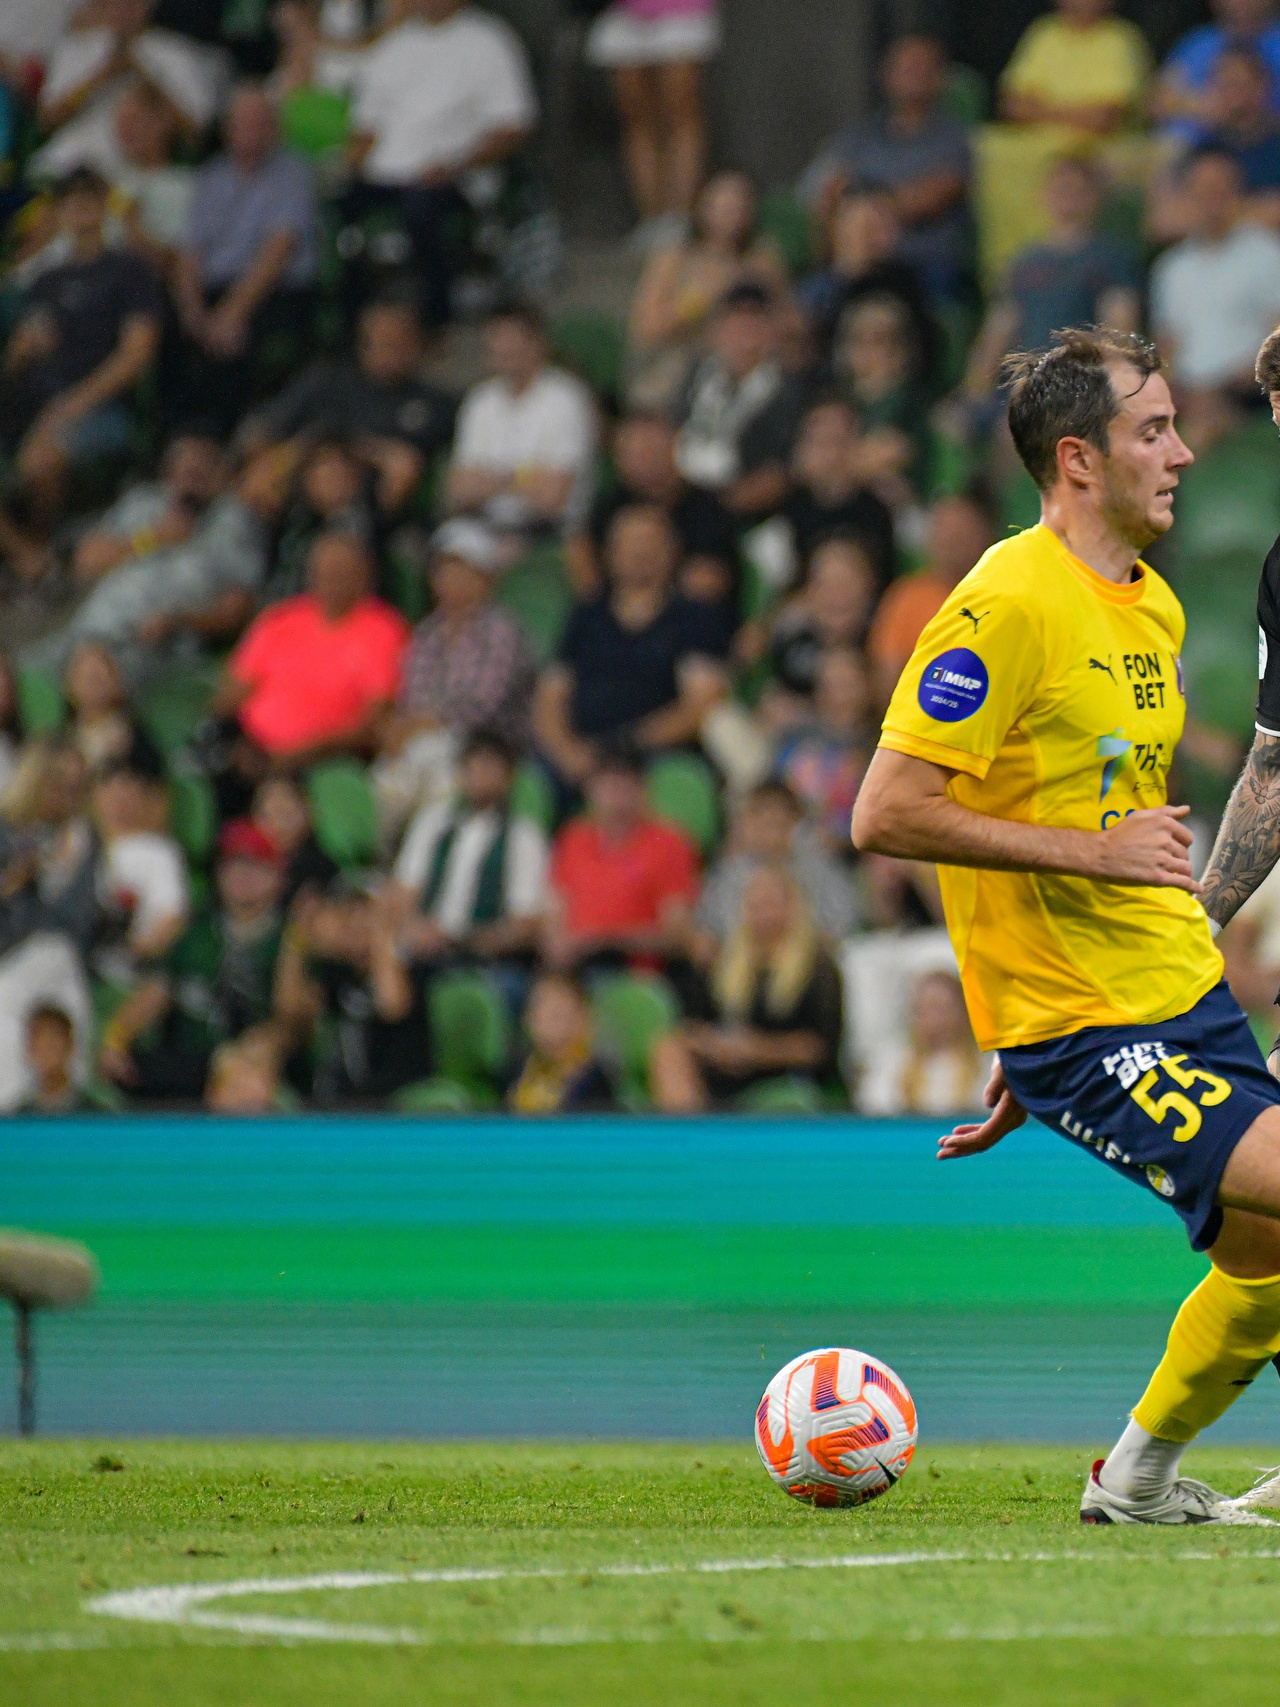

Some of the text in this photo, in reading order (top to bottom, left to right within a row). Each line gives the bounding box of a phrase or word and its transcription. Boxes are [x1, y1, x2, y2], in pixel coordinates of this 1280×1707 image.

[1123, 652, 1161, 680] FON
[944, 671, 983, 691] МИР
[1134, 682, 1166, 710] BET
[1130, 1053, 1232, 1143] 55
